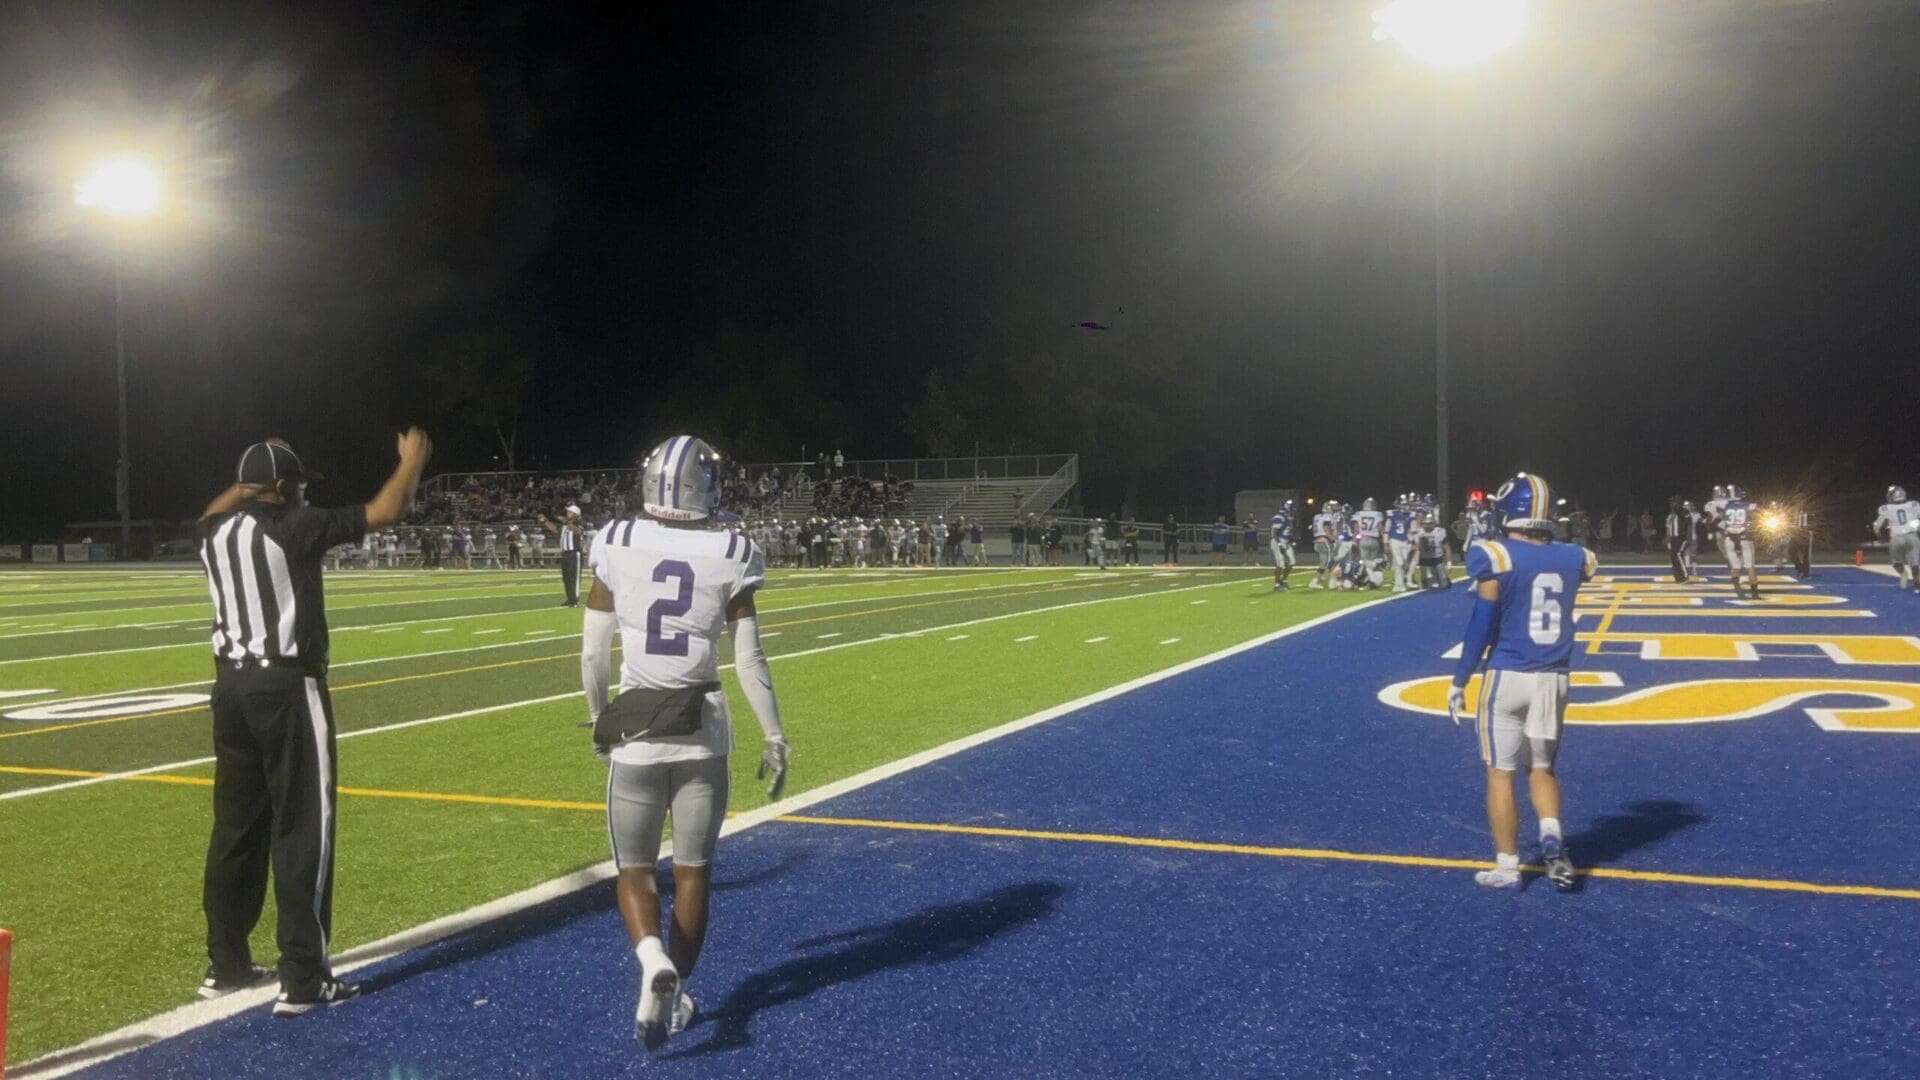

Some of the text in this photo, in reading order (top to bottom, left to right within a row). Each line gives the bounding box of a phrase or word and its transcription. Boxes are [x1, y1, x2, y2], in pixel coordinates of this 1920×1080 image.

[651, 506, 690, 520] Riddell
[1725, 508, 1747, 525] 39
[1897, 508, 1907, 525] 0
[1361, 516, 1375, 531] 57
[1395, 523, 1405, 534] 3
[645, 559, 696, 657] 2
[1529, 572, 1564, 645] 6
